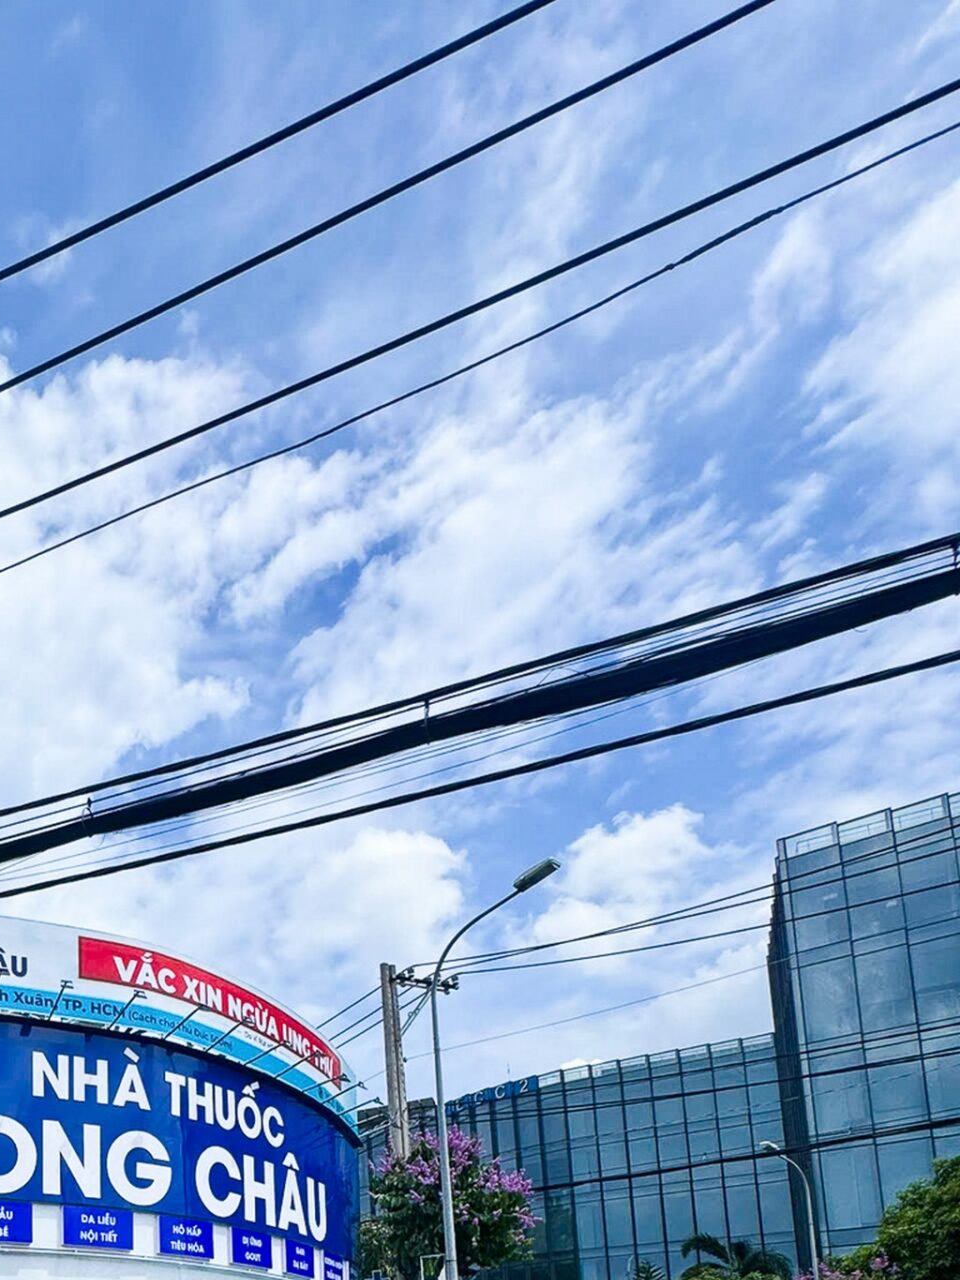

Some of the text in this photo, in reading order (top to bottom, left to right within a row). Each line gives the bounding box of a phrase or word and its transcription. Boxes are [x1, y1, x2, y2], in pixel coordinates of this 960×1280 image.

[112, 952, 176, 994] VẮC
[182, 975, 222, 1011] XIN
[64, 998, 86, 1012] TP.
[32, 1047, 285, 1148] NHÀ THUỐC
[195, 1145, 327, 1242] CHÂU
[81, 1214, 95, 1224] DA
[80, 1229, 118, 1243] NỘI TIẾT
[170, 1240, 186, 1251] TIÊU
